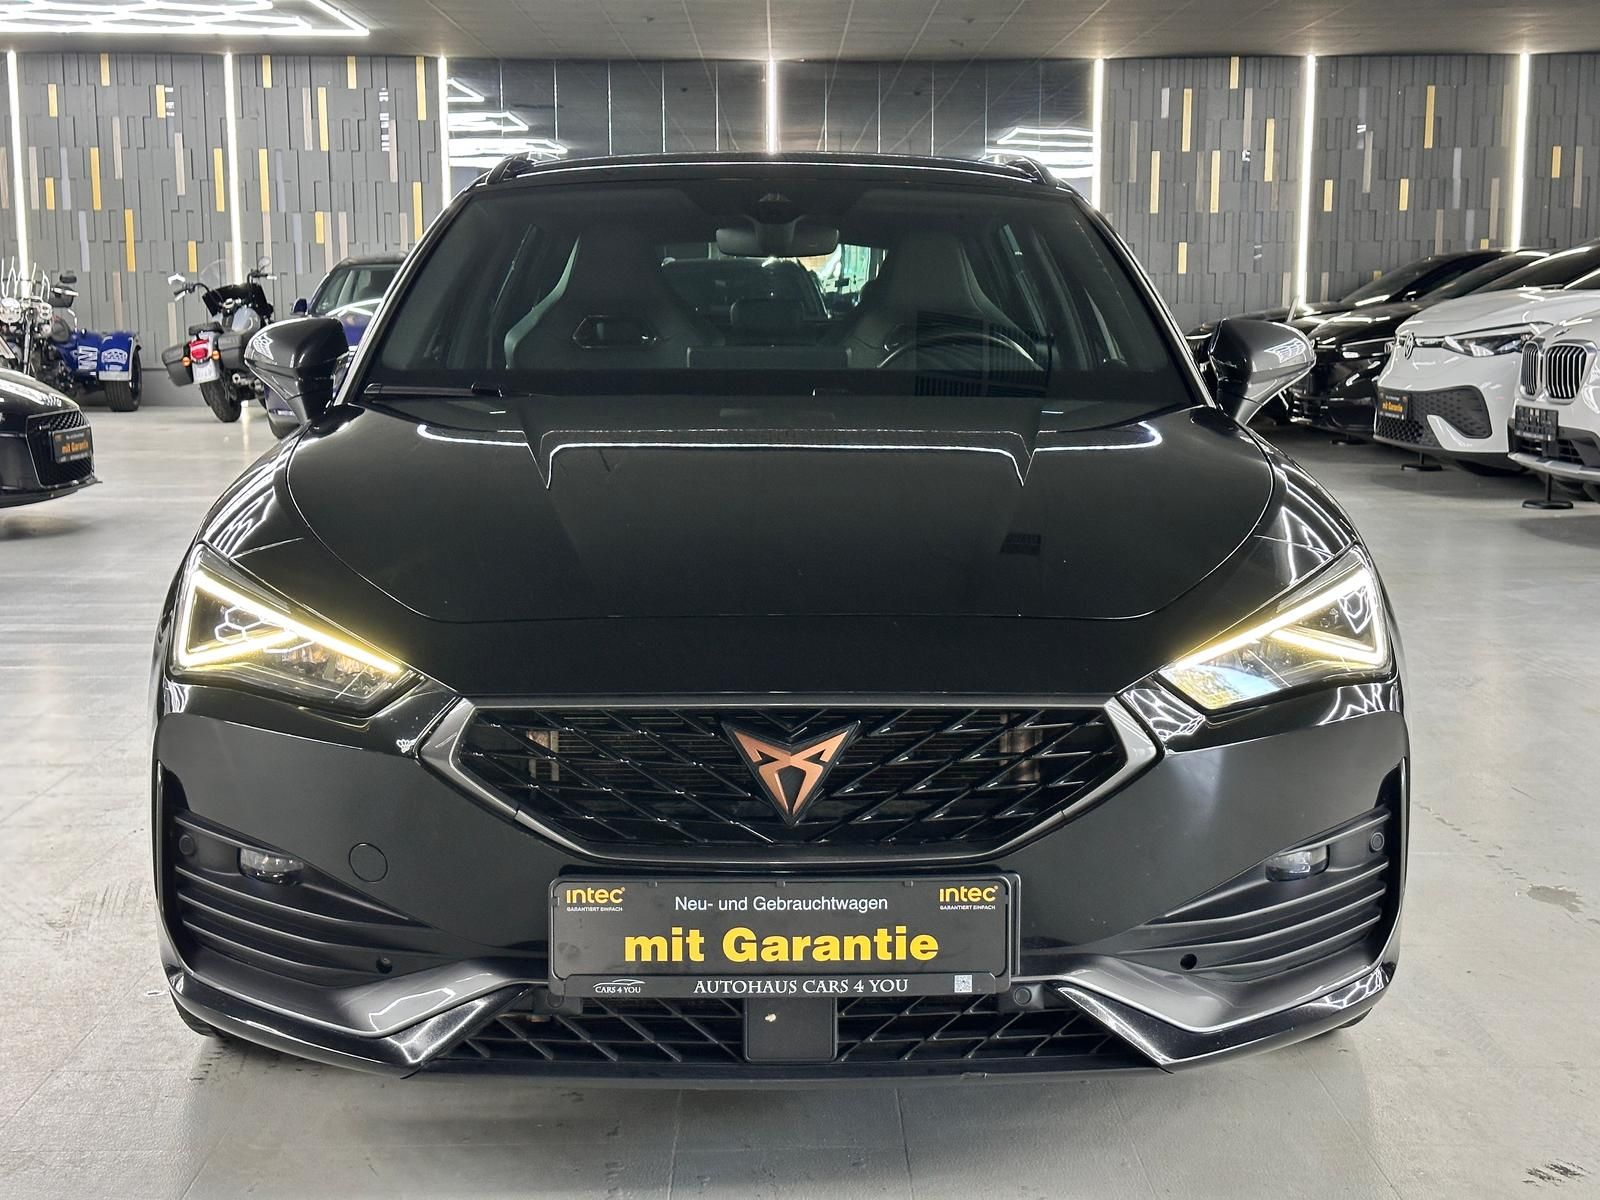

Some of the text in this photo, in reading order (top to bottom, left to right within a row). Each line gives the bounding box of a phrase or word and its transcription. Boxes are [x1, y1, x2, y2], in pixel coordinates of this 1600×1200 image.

[675, 896, 888, 914] Neu- und Gebrauchtwagen
[624, 925, 939, 963] mit Garantie
[693, 979, 909, 994] AUTOHAUS CARS 4 YOU
